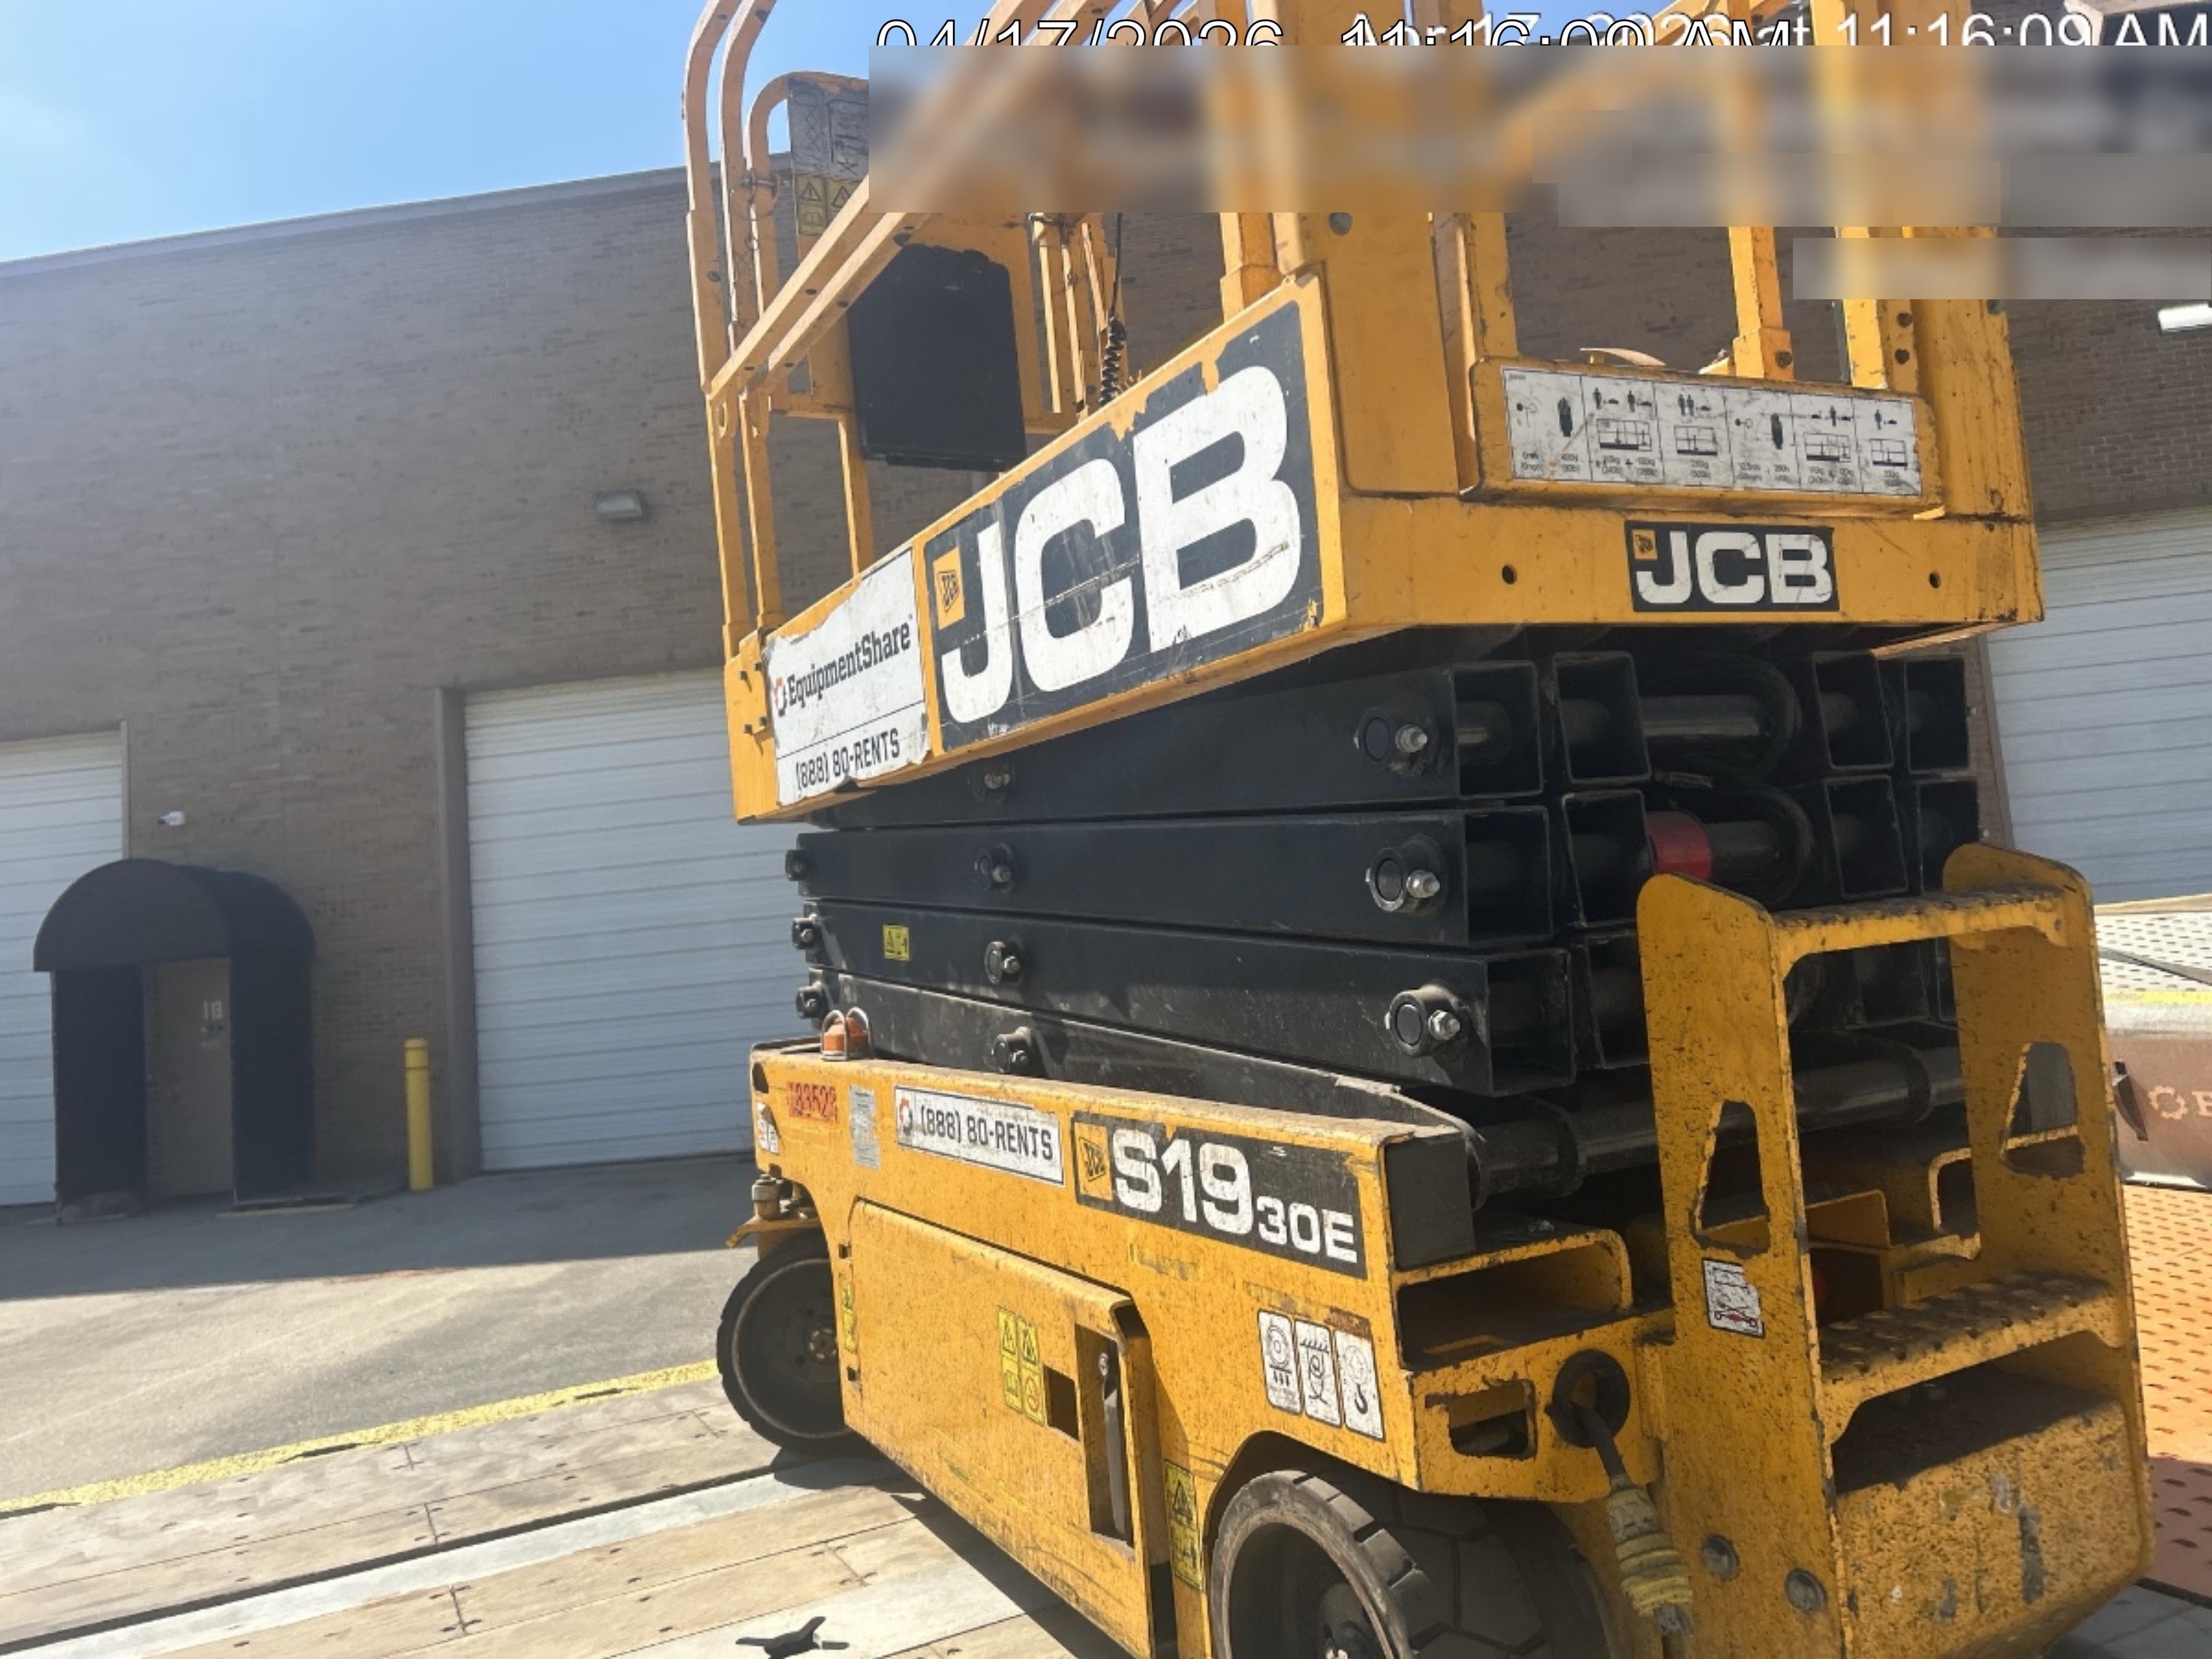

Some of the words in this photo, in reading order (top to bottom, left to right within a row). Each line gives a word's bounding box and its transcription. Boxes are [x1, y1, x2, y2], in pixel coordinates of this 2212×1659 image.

[942, 366, 1301, 723] JCB
[1636, 530, 1833, 603] JCB
[787, 621, 911, 708] EquipmentShare
[796, 751, 829, 791] (888)
[832, 728, 901, 778] 80-RENTS
[920, 1105, 962, 1143] (888)
[967, 1115, 1053, 1161] 80-RENTS
